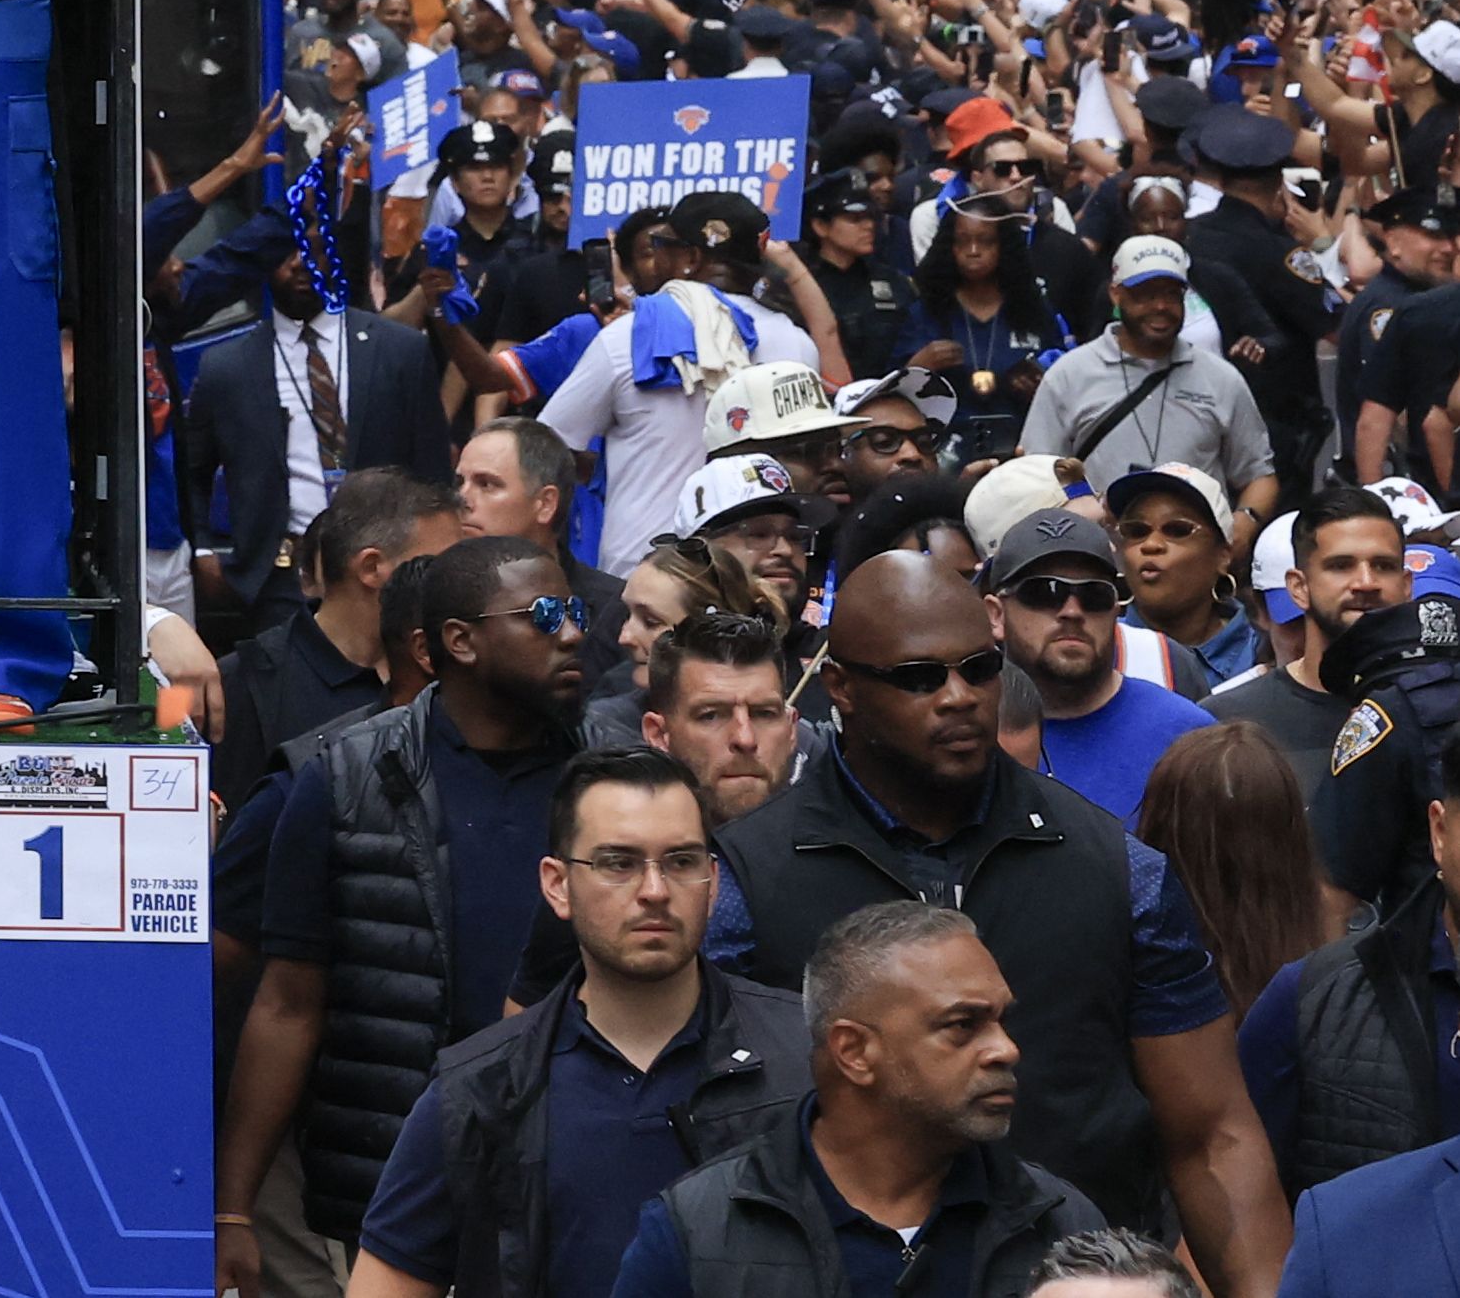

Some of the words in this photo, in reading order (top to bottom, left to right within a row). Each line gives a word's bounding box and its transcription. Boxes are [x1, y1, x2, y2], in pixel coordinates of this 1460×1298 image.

[584, 143, 656, 180] WON
[663, 141, 726, 177] FOR
[734, 138, 796, 174] THE
[141, 769, 182, 801] 34
[23, 825, 64, 920] 1
[130, 878, 199, 890] 973-778-3333
[132, 893, 197, 912] PARADE
[130, 914, 199, 934] VEHICLE
